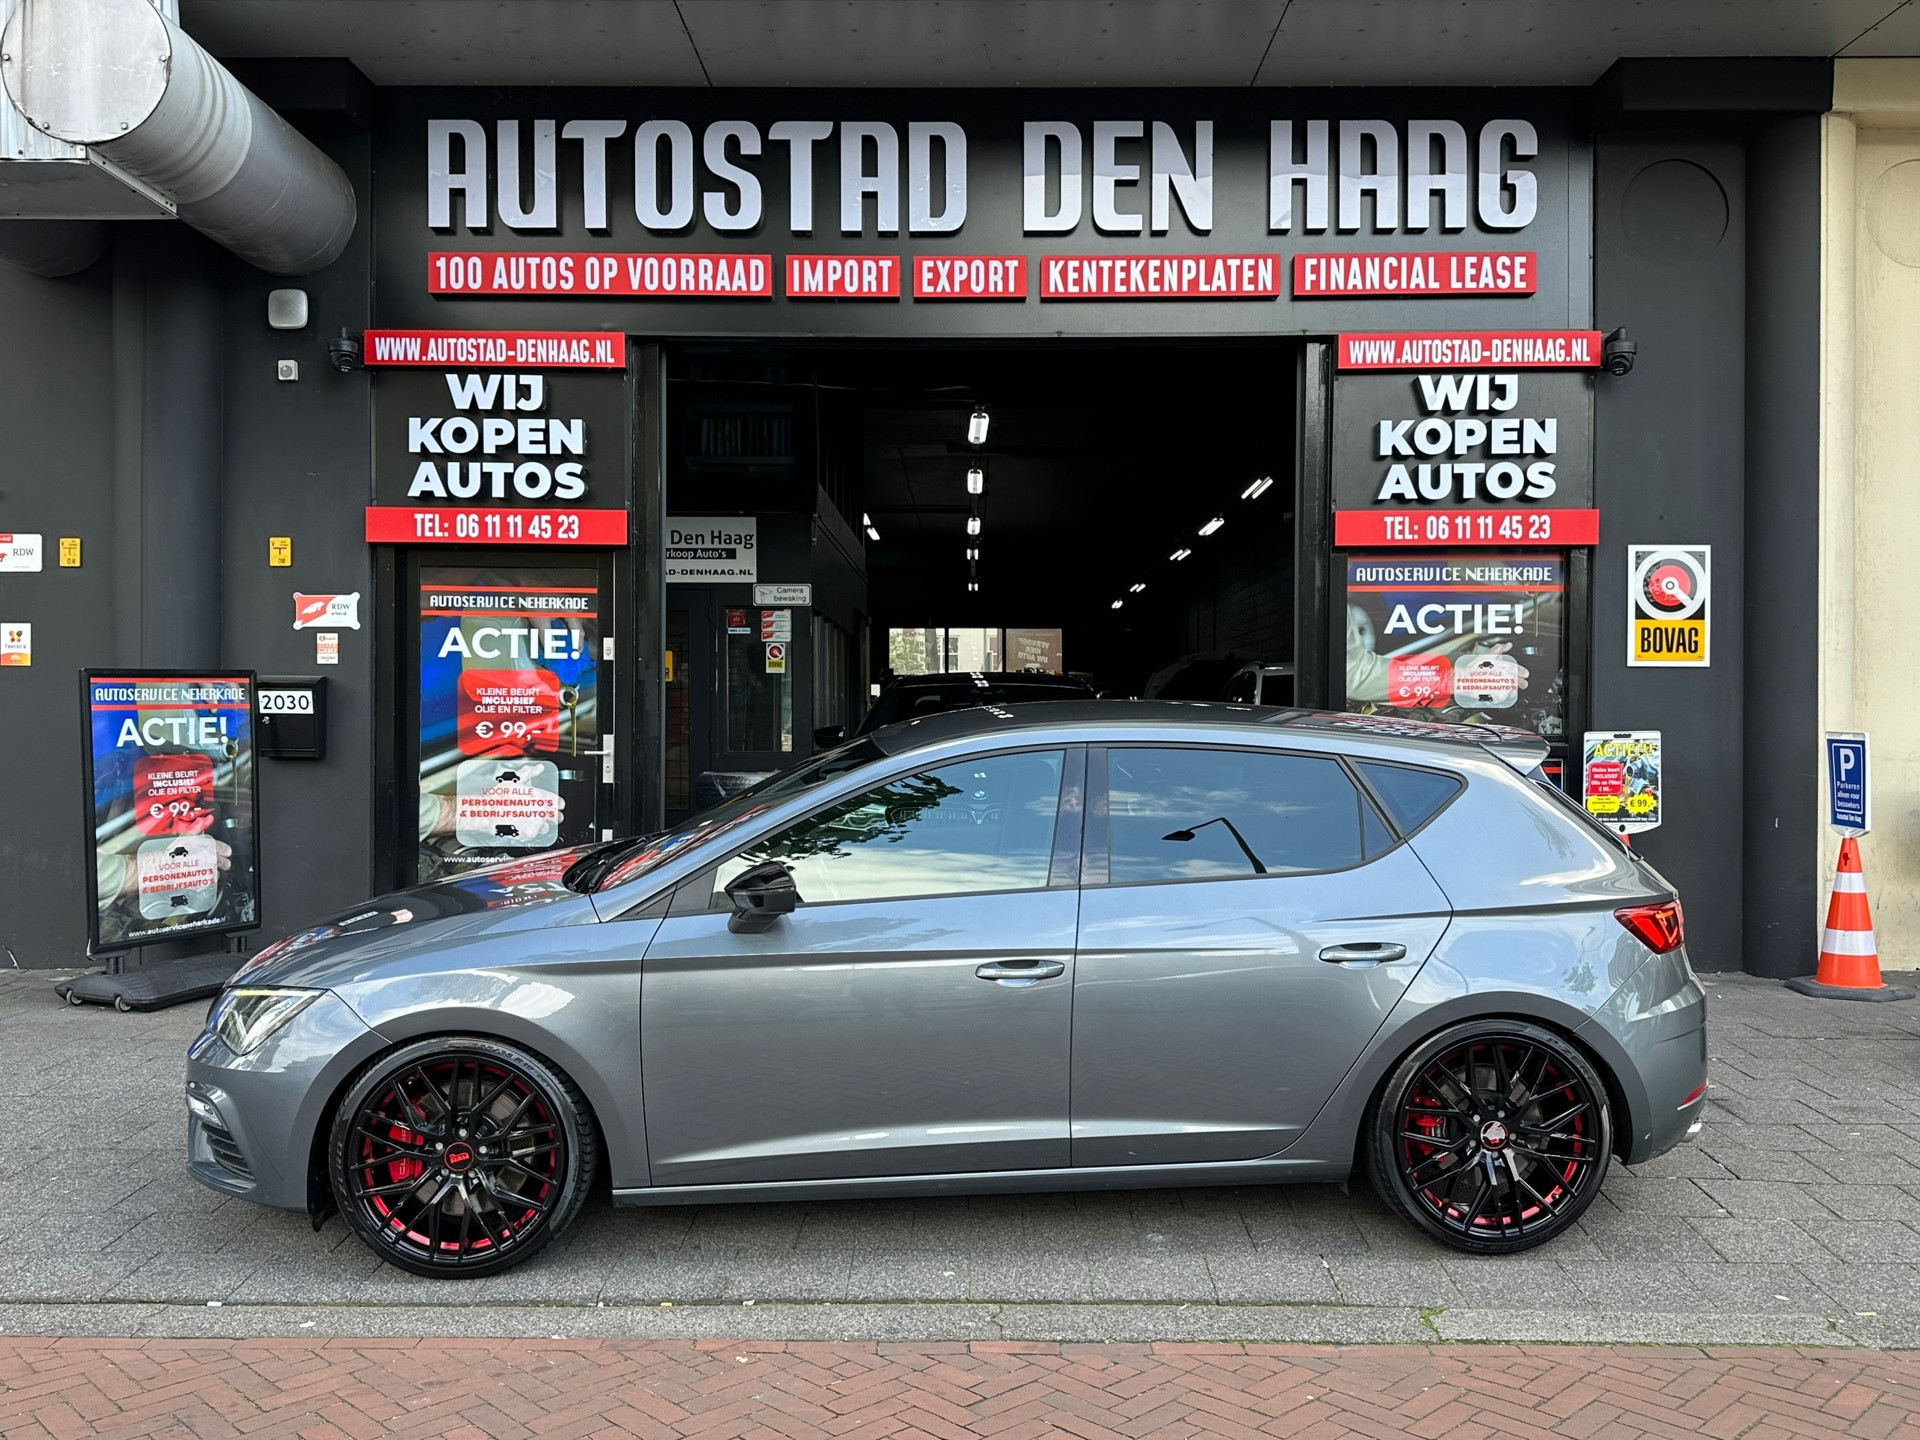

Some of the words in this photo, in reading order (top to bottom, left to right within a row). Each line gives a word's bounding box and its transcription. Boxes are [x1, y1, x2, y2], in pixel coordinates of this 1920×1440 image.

[427, 119, 968, 233] AUTOSTAD
[1023, 120, 1214, 234] DEN
[1268, 118, 1539, 233] HAAG
[435, 255, 482, 290] 100
[492, 256, 574, 291] AUTOS
[585, 256, 618, 291] OP
[628, 257, 765, 293] VOORRAAD
[792, 258, 893, 293] IMPORT
[922, 258, 1019, 294] EXPORT
[1048, 259, 1274, 293] KENTEKENPLATEN
[1304, 256, 1443, 292] FINANCIAL
[1450, 255, 1527, 290] LEASE
[374, 337, 615, 364] WWW.AUTOSTAD-DENHAAG.NL
[1348, 338, 1591, 365] WWW.AUTOSTAD-DENHAAG.NL
[446, 374, 545, 412] WIJ
[1416, 374, 1519, 412] WIJ
[407, 417, 585, 455] KOPEN
[1378, 417, 1557, 456] KOPEN
[407, 461, 586, 499] AUTOS
[1377, 461, 1557, 501] AUTOS
[414, 514, 449, 537] TEL:
[456, 514, 482, 538] 06
[485, 515, 501, 538] 11
[506, 515, 523, 538] 11
[528, 515, 553, 538] 45
[557, 515, 579, 538] 23
[1384, 516, 1419, 540] TEL:
[1426, 515, 1449, 540] 06
[1455, 515, 1471, 539] 11
[1475, 515, 1493, 539] 11
[1498, 514, 1525, 538] 45
[1528, 514, 1551, 538] 23
[670, 529, 705, 545] Den
[710, 529, 754, 549] Haag
[13, 548, 34, 556] RDW
[696, 549, 727, 559] Auto's
[1355, 567, 1461, 581] AUTOSERVICE
[1465, 567, 1552, 581] NEHERKADE
[429, 595, 516, 608] AUTOSERVICE
[518, 596, 589, 610] NEHERKADE
[773, 594, 807, 603] bewaking
[1383, 603, 1524, 635] ACTIE!
[437, 626, 582, 660] ACTIE!
[1640, 626, 1699, 654] BOVAG
[95, 687, 178, 702] AUTOSERVICE
[181, 687, 245, 700] NEHERKADE
[476, 687, 508, 696] KLEINE
[510, 687, 541, 696] BEURT
[481, 696, 536, 705] INCLUSIEF
[1399, 686, 1411, 697] €
[1414, 686, 1441, 699] 99,-
[261, 694, 311, 711] 2030
[474, 705, 496, 714] OLIE
[498, 705, 510, 714] EN
[512, 705, 543, 714] FILTER
[116, 716, 229, 748] ACTIE!
[475, 721, 494, 739] €
[500, 721, 542, 741] 99,-
[1839, 747, 1855, 782] P
[147, 772, 175, 780] KLEINE
[175, 770, 199, 779] BEURT
[152, 779, 196, 788] INCLUSIEF
[1837, 780, 1860, 790] Parkeren
[147, 787, 166, 796] OLIE
[166, 786, 178, 795] EN
[178, 785, 202, 795] FILTER
[482, 787, 509, 796] VOOR
[511, 787, 534, 795] ALLE
[149, 803, 165, 819] €
[168, 801, 202, 819] 99,-
[461, 799, 554, 807] PERSONENAUTO'S
[1629, 799, 1636, 808] €
[460, 810, 468, 818] &
[470, 810, 555, 818] BEDRIJFSAUTO'S
[158, 861, 182, 871] VOOR
[183, 859, 200, 868] ALLE
[142, 867, 214, 884] PERSONENAUTO'S
[149, 877, 216, 894] BEDRIJFSAUTO'S
[128, 916, 227, 938] www.autoserviceneherkade.nl
